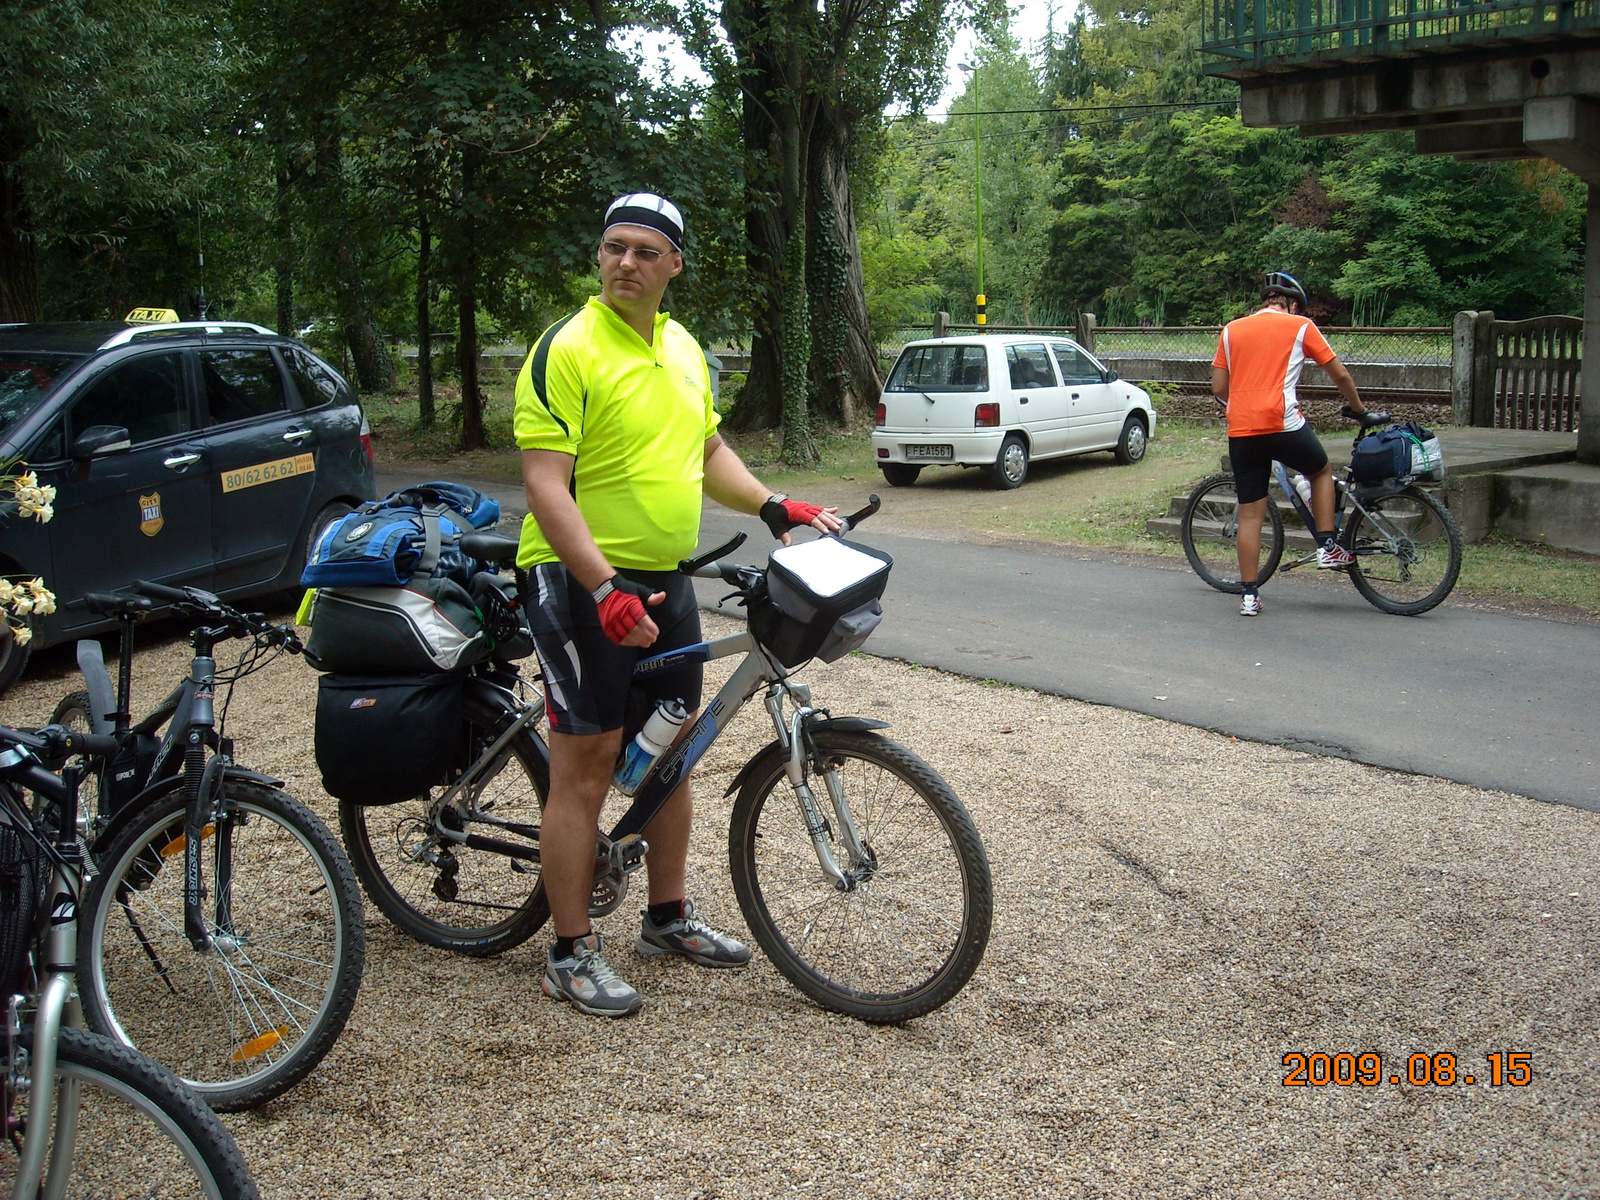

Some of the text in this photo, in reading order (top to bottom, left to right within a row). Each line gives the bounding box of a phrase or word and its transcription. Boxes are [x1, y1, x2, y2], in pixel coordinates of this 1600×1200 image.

[130, 310, 166, 321] TAXI
[226, 461, 294, 489] 80/62 62 62
[142, 498, 157, 507] CITY
[143, 506, 160, 521] TAXI
